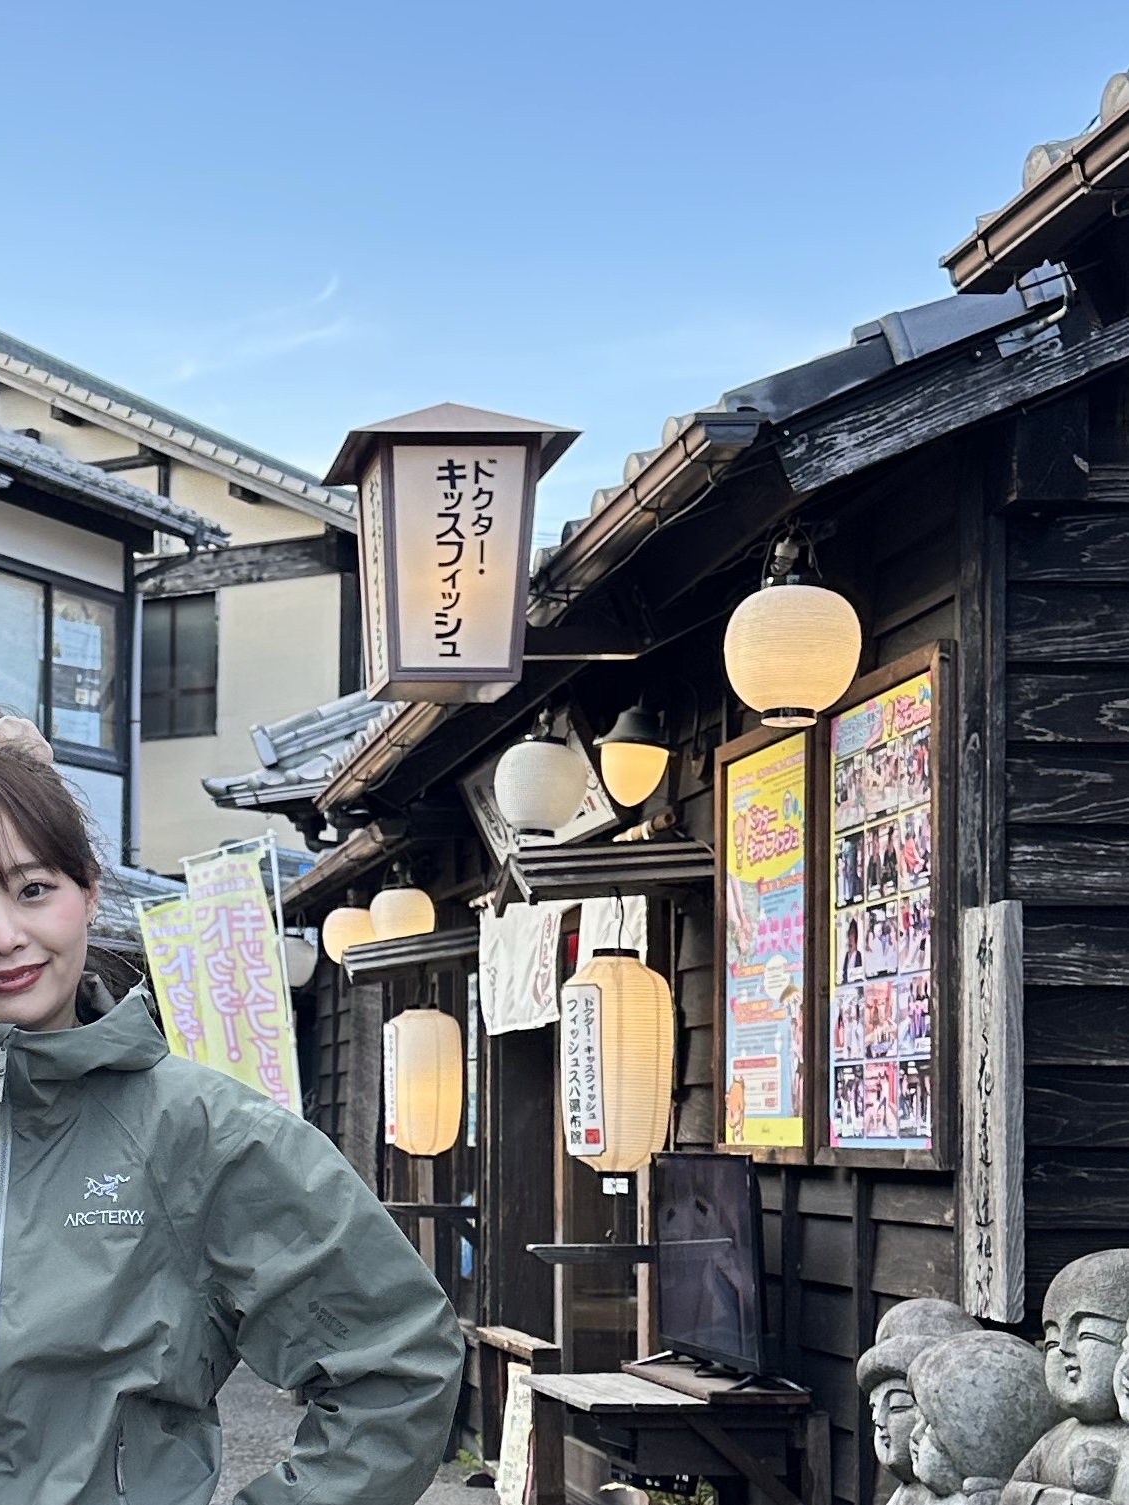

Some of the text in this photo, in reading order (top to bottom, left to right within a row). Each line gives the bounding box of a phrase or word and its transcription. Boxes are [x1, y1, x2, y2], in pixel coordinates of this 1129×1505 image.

[434, 458, 468, 659] キッスフィッシュ
